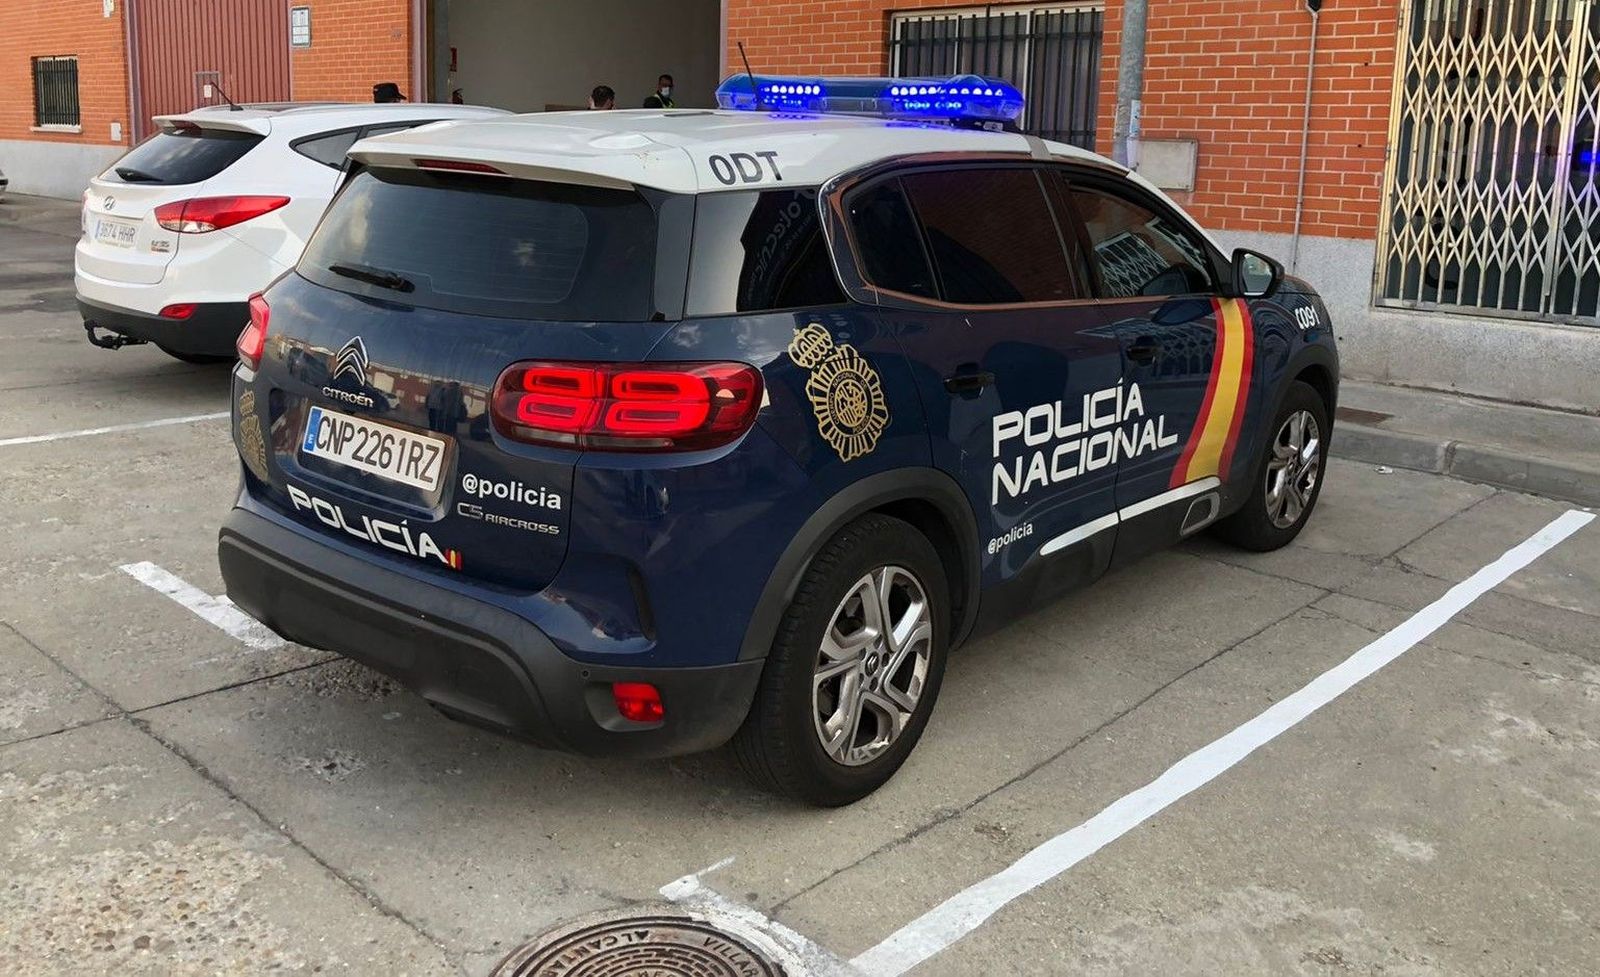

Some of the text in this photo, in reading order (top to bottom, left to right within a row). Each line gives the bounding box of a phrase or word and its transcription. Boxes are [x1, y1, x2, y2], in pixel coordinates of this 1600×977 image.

[993, 377, 1145, 458] POLICÍA
[992, 413, 1179, 506] NACIONAL
[462, 473, 561, 510] @policia
[286, 483, 448, 564] POLICÍA
[485, 513, 560, 535] AIRCROSS
[987, 521, 1033, 555] @policia
